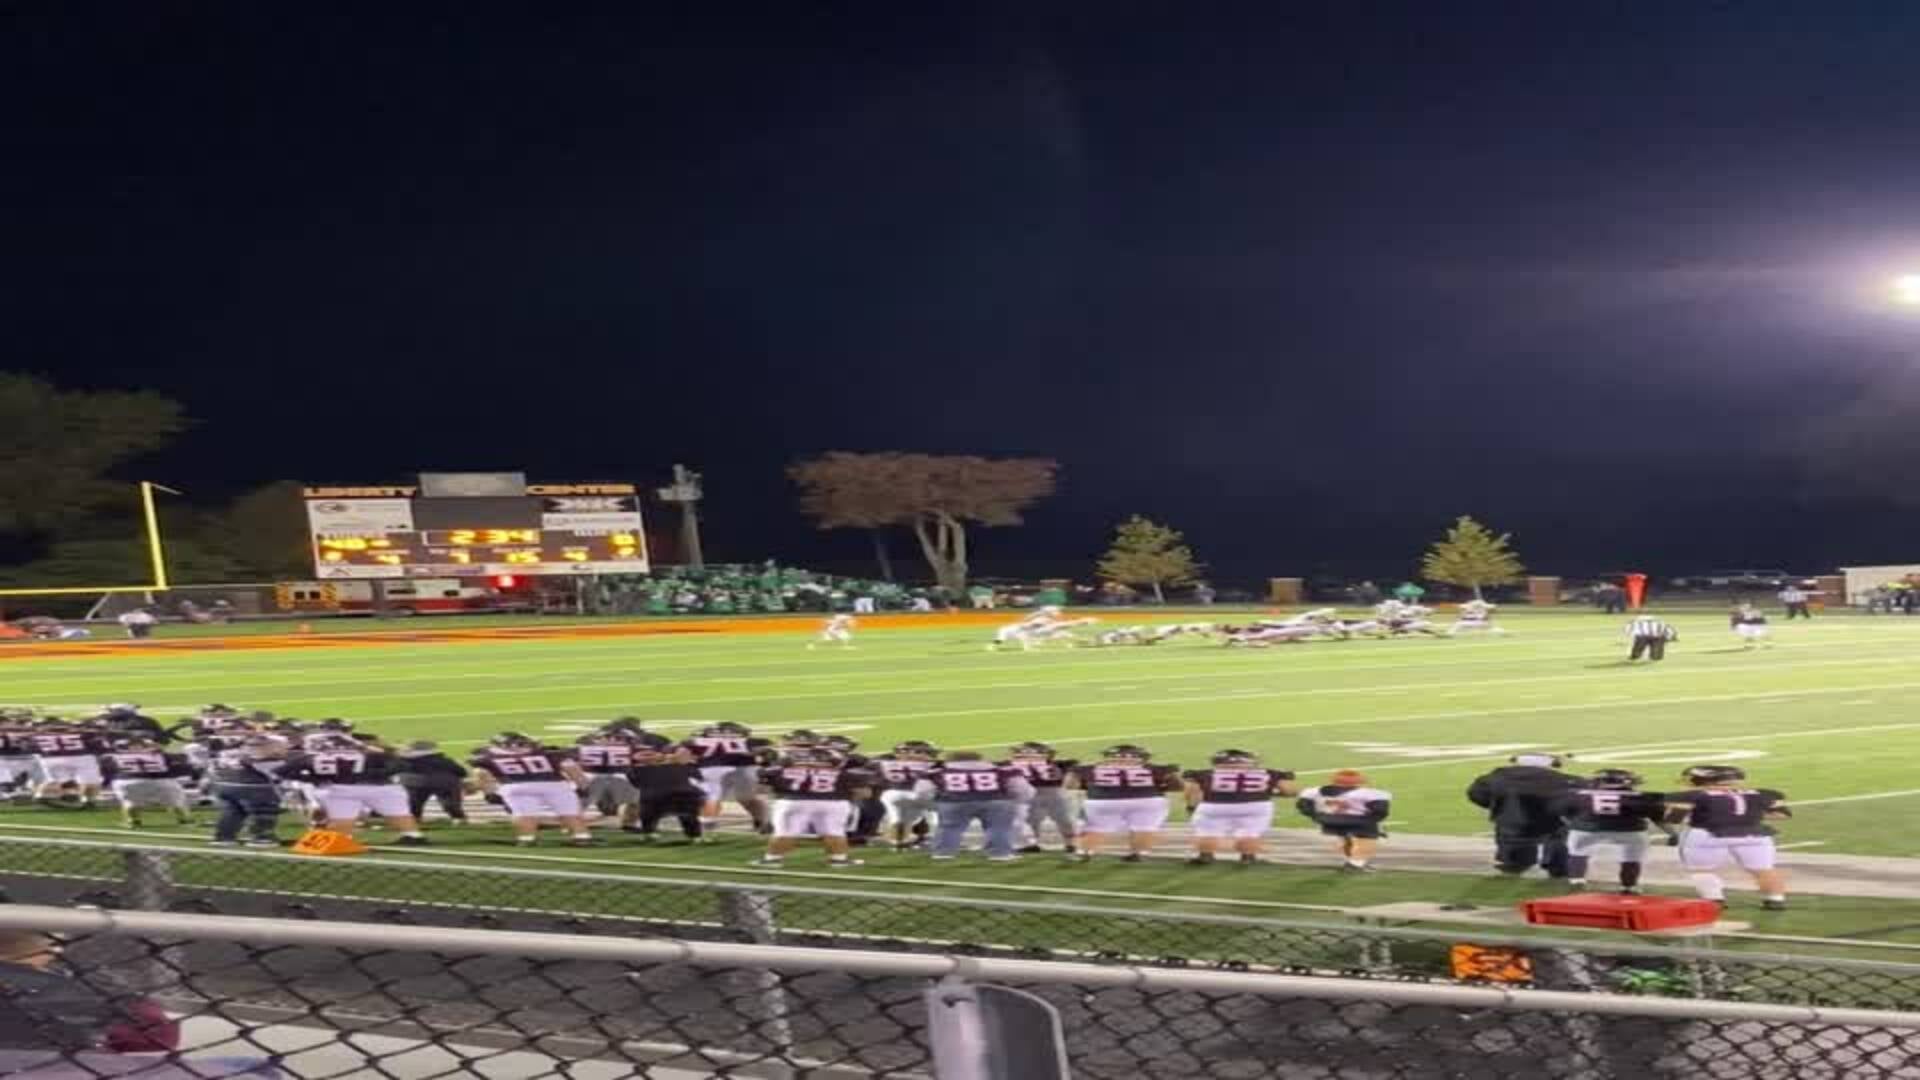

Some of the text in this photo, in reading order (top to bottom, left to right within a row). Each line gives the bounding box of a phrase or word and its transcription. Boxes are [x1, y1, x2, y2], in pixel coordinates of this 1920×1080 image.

[304, 484, 636, 497] LIBERTY CENTER
[34, 734, 84, 752] 35
[696, 736, 748, 756] 70
[314, 752, 364, 774] 67
[492, 756, 553, 775] 60
[580, 745, 631, 766] 56
[782, 767, 842, 792] 78
[943, 773, 998, 791] 88
[1094, 765, 1154, 786] 55
[1211, 769, 1271, 792] 63
[1592, 791, 1620, 815] 6
[1729, 791, 1745, 815] 1
